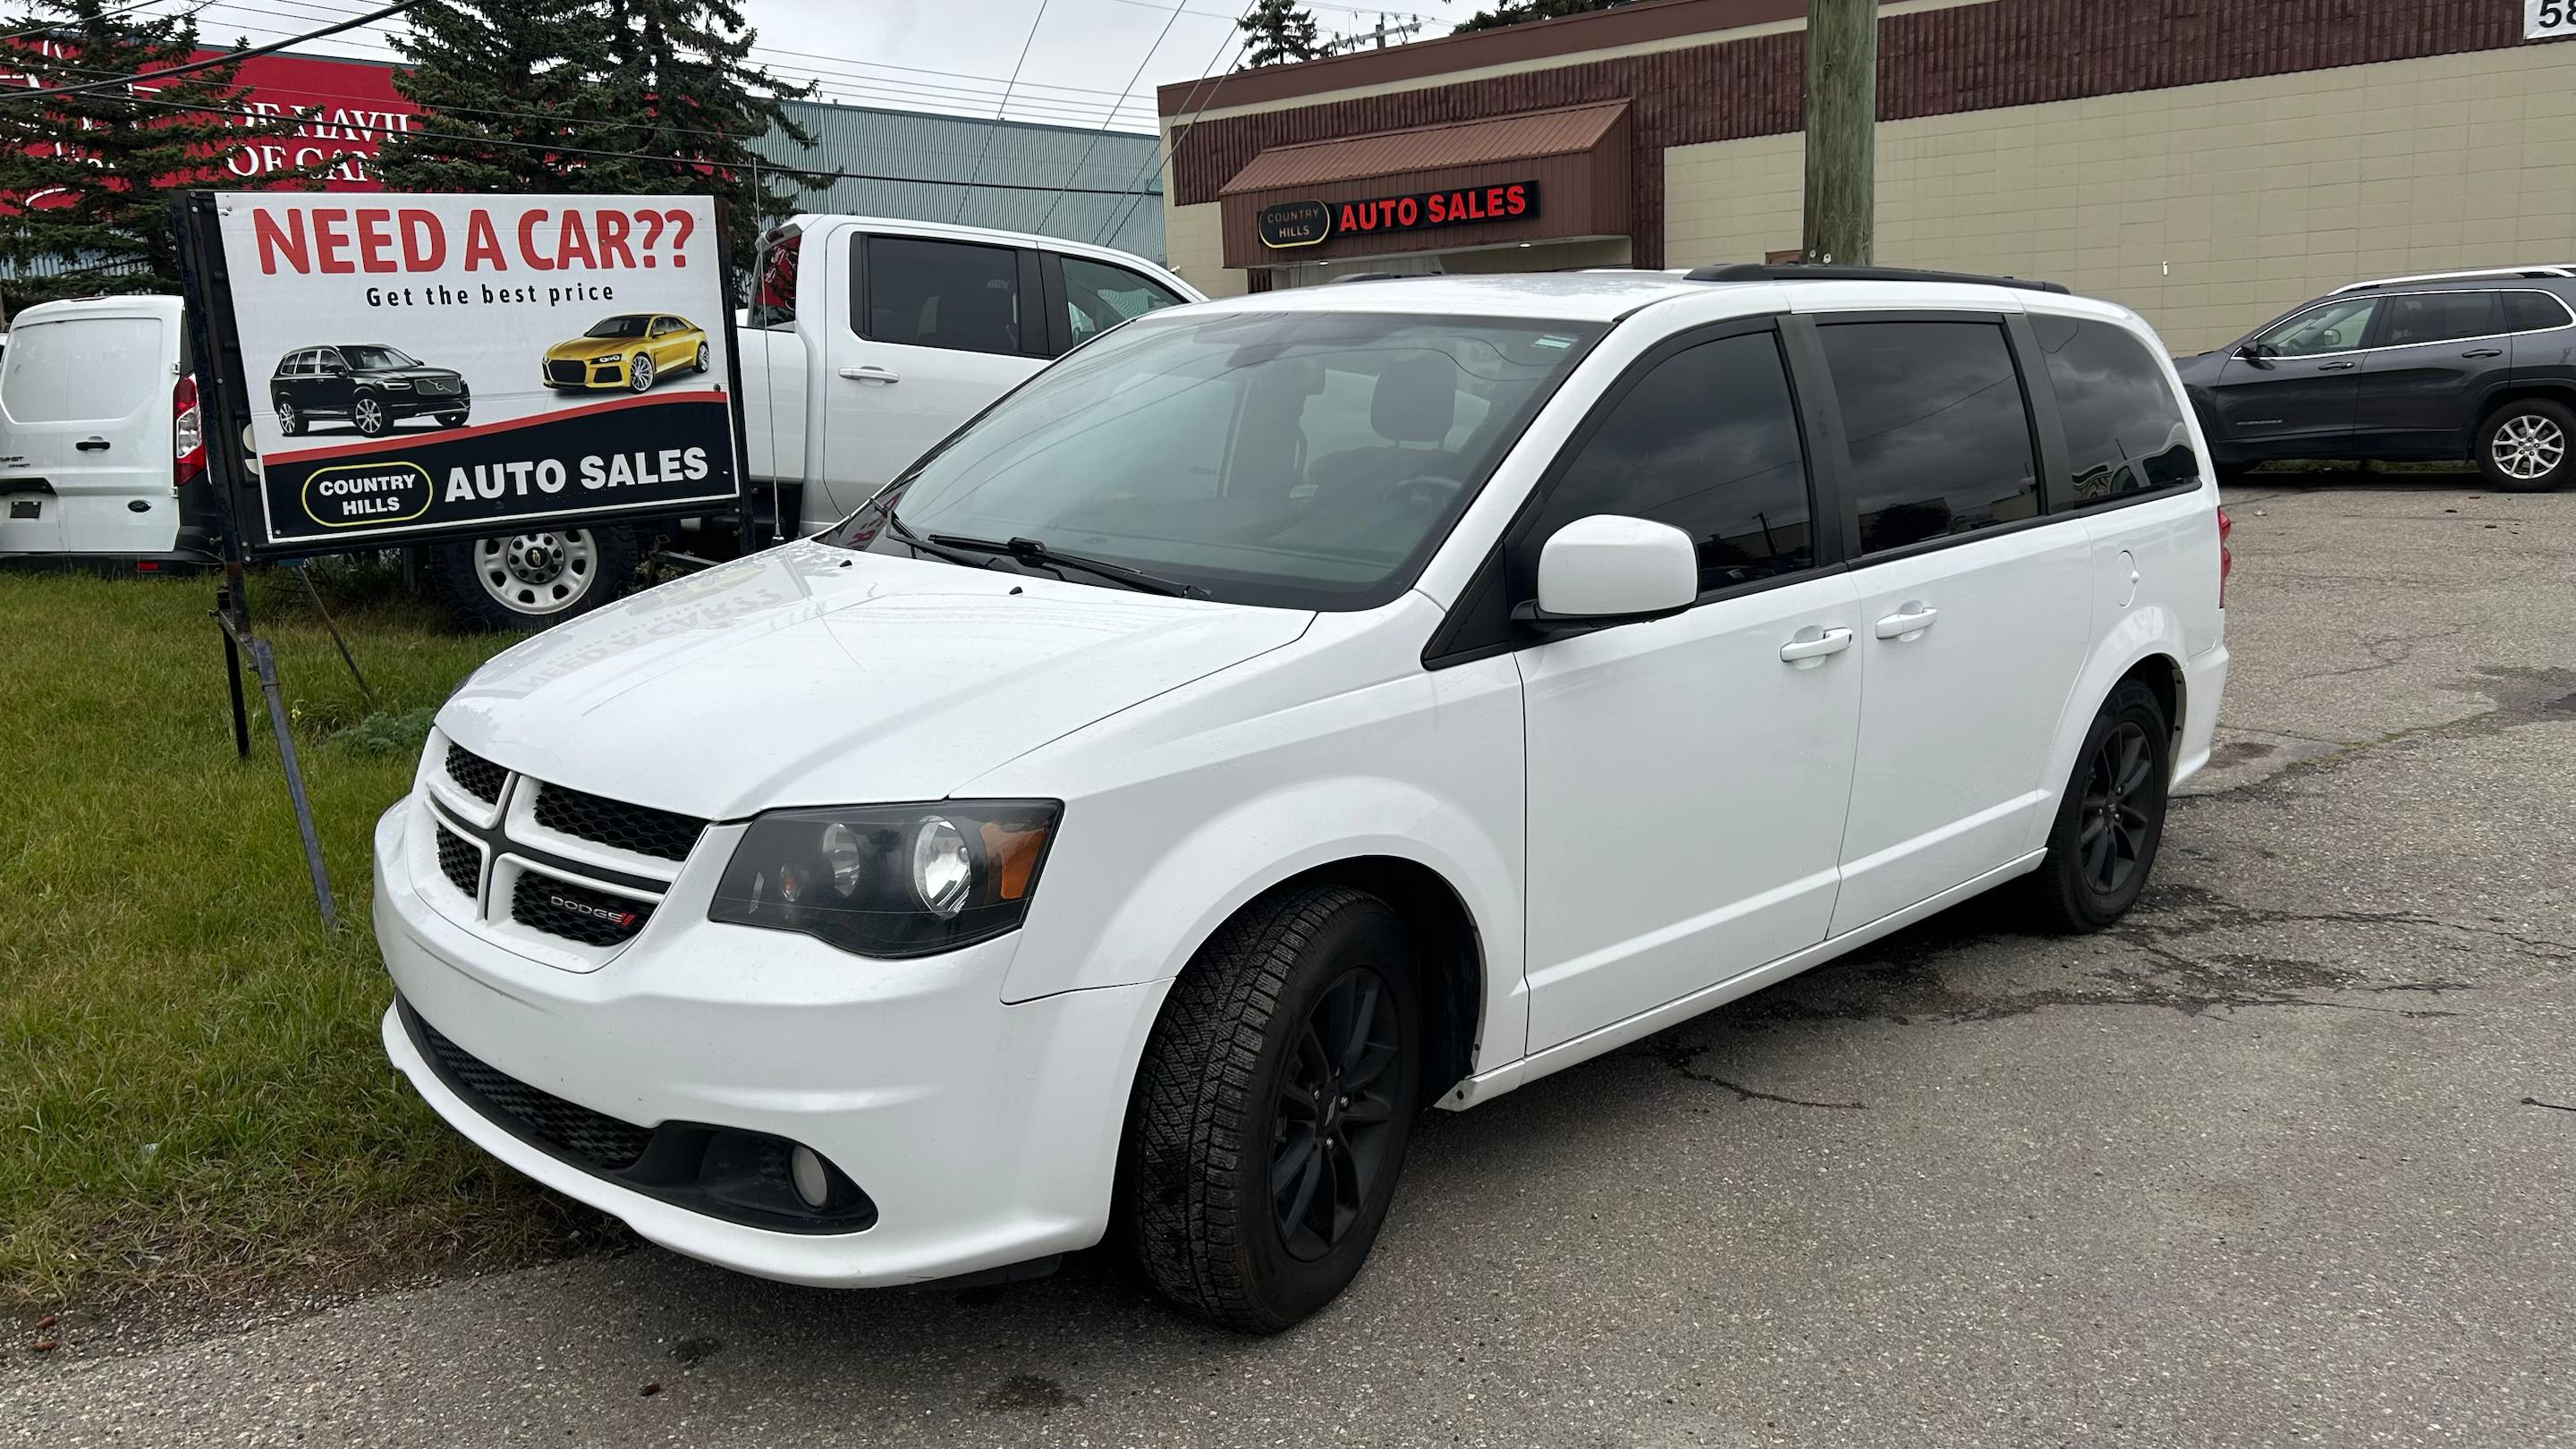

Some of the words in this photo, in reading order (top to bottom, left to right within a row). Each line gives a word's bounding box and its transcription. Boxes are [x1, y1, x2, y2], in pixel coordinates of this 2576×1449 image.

[227, 143, 286, 177] OF
[1267, 208, 1318, 224] COUNTRY
[1340, 198, 1418, 232] AUTO
[1428, 185, 1526, 223] SALES
[252, 208, 445, 274] NEED
[464, 209, 507, 271] A
[518, 209, 694, 271] CAR??
[1279, 225, 1310, 238] HILLS
[366, 287, 413, 307] Get
[425, 284, 469, 306] the
[481, 284, 537, 304] best
[548, 282, 614, 306] price
[318, 473, 416, 496] COUNTRY
[445, 458, 566, 503] AUTO
[580, 446, 708, 490] SALES
[342, 496, 401, 516] HILLS
[550, 895, 623, 923] DODGE
